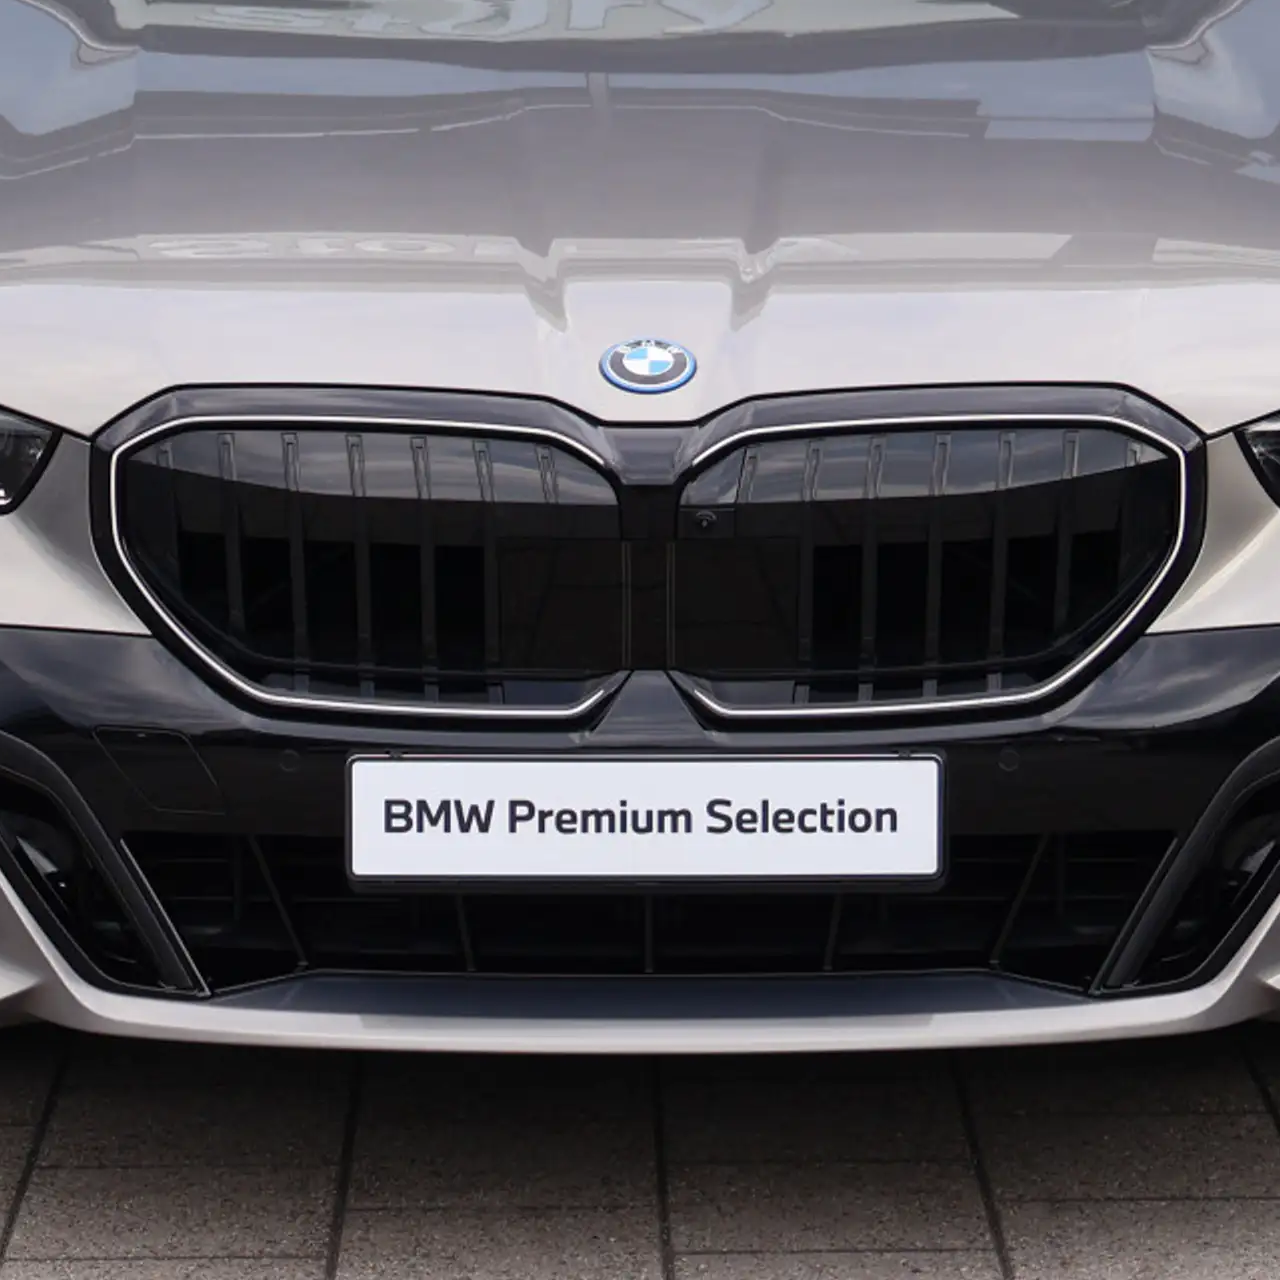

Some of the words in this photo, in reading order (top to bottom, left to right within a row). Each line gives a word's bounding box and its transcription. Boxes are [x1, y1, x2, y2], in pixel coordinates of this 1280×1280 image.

[383, 800, 495, 834] BMW
[508, 800, 693, 835] Premium
[705, 797, 898, 834] Selection
